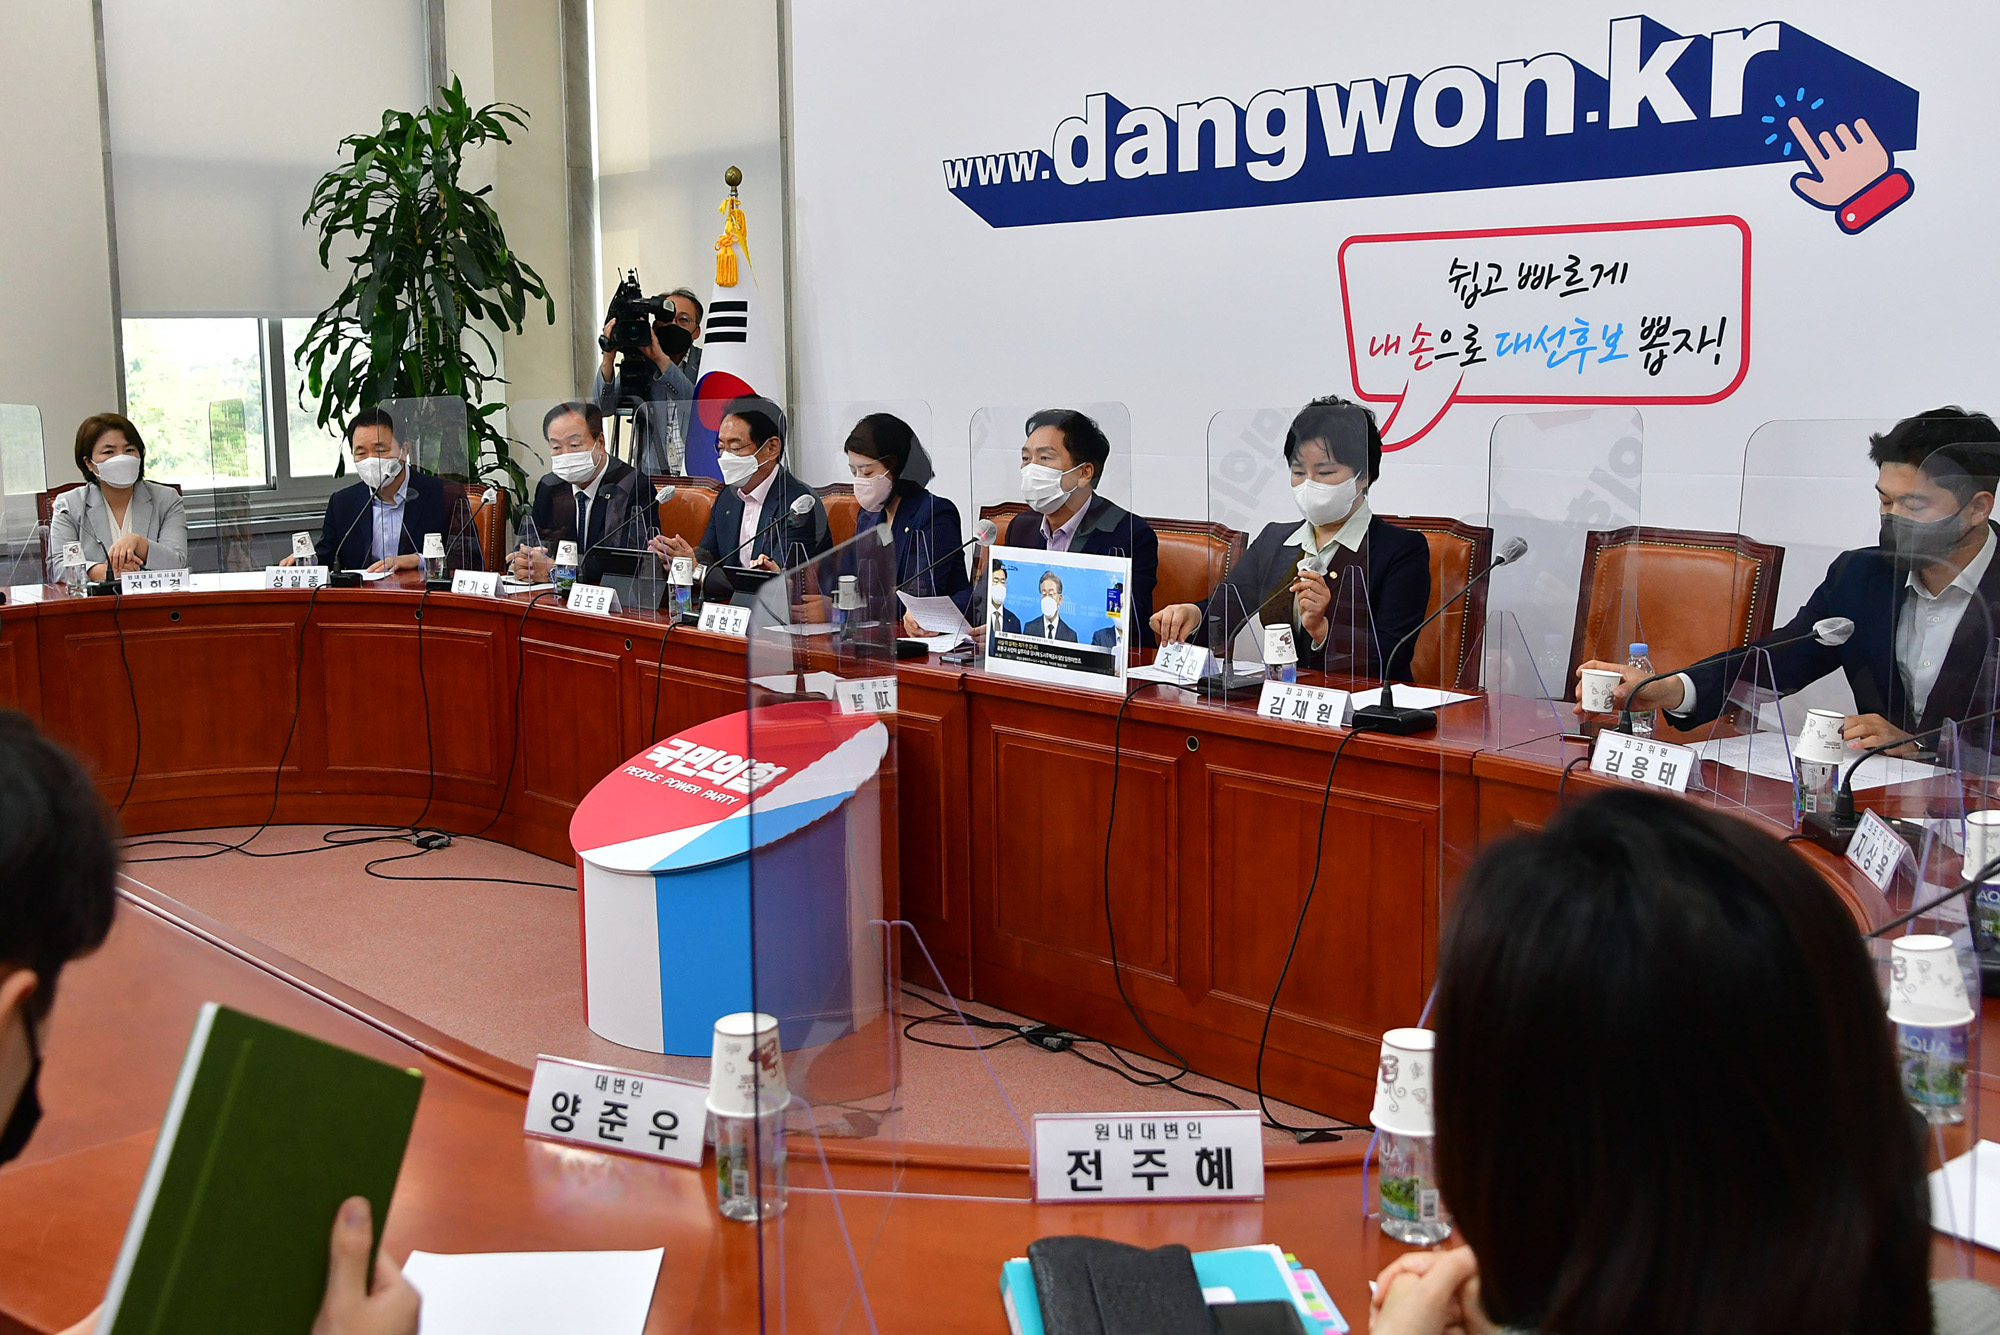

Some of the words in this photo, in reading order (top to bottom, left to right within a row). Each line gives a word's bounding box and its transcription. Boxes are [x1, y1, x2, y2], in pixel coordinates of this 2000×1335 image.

[943, 15, 1781, 189] www.dangwon.kr
[1448, 256, 1508, 309] 쉽고
[1518, 254, 1629, 298] 빠르게
[1369, 333, 1400, 357] 내
[1408, 322, 1487, 371] 손으로
[1495, 317, 1629, 375] 대선후보
[1638, 315, 1727, 376] 뽑자!
[273, 575, 319, 588] 성일종
[573, 594, 605, 610] 김도읍
[705, 614, 742, 632] 배현진
[1160, 651, 1199, 676] 조수진
[1285, 686, 1325, 700] 최고위원
[1269, 696, 1333, 723] 김재원
[1624, 739, 1668, 757] 최고위원
[645, 737, 788, 796] 국민의힘
[1605, 749, 1678, 786] 김용태
[622, 765, 665, 783] PEOPLE
[661, 776, 702, 795] POWER
[700, 789, 740, 806] PARTY
[1853, 832, 1889, 882] 지상욱
[595, 1074, 644, 1098] 대변인
[550, 1090, 680, 1150] 양준우
[1094, 1121, 1202, 1141] 원내대변인
[1066, 1145, 1234, 1192] 전주혜
